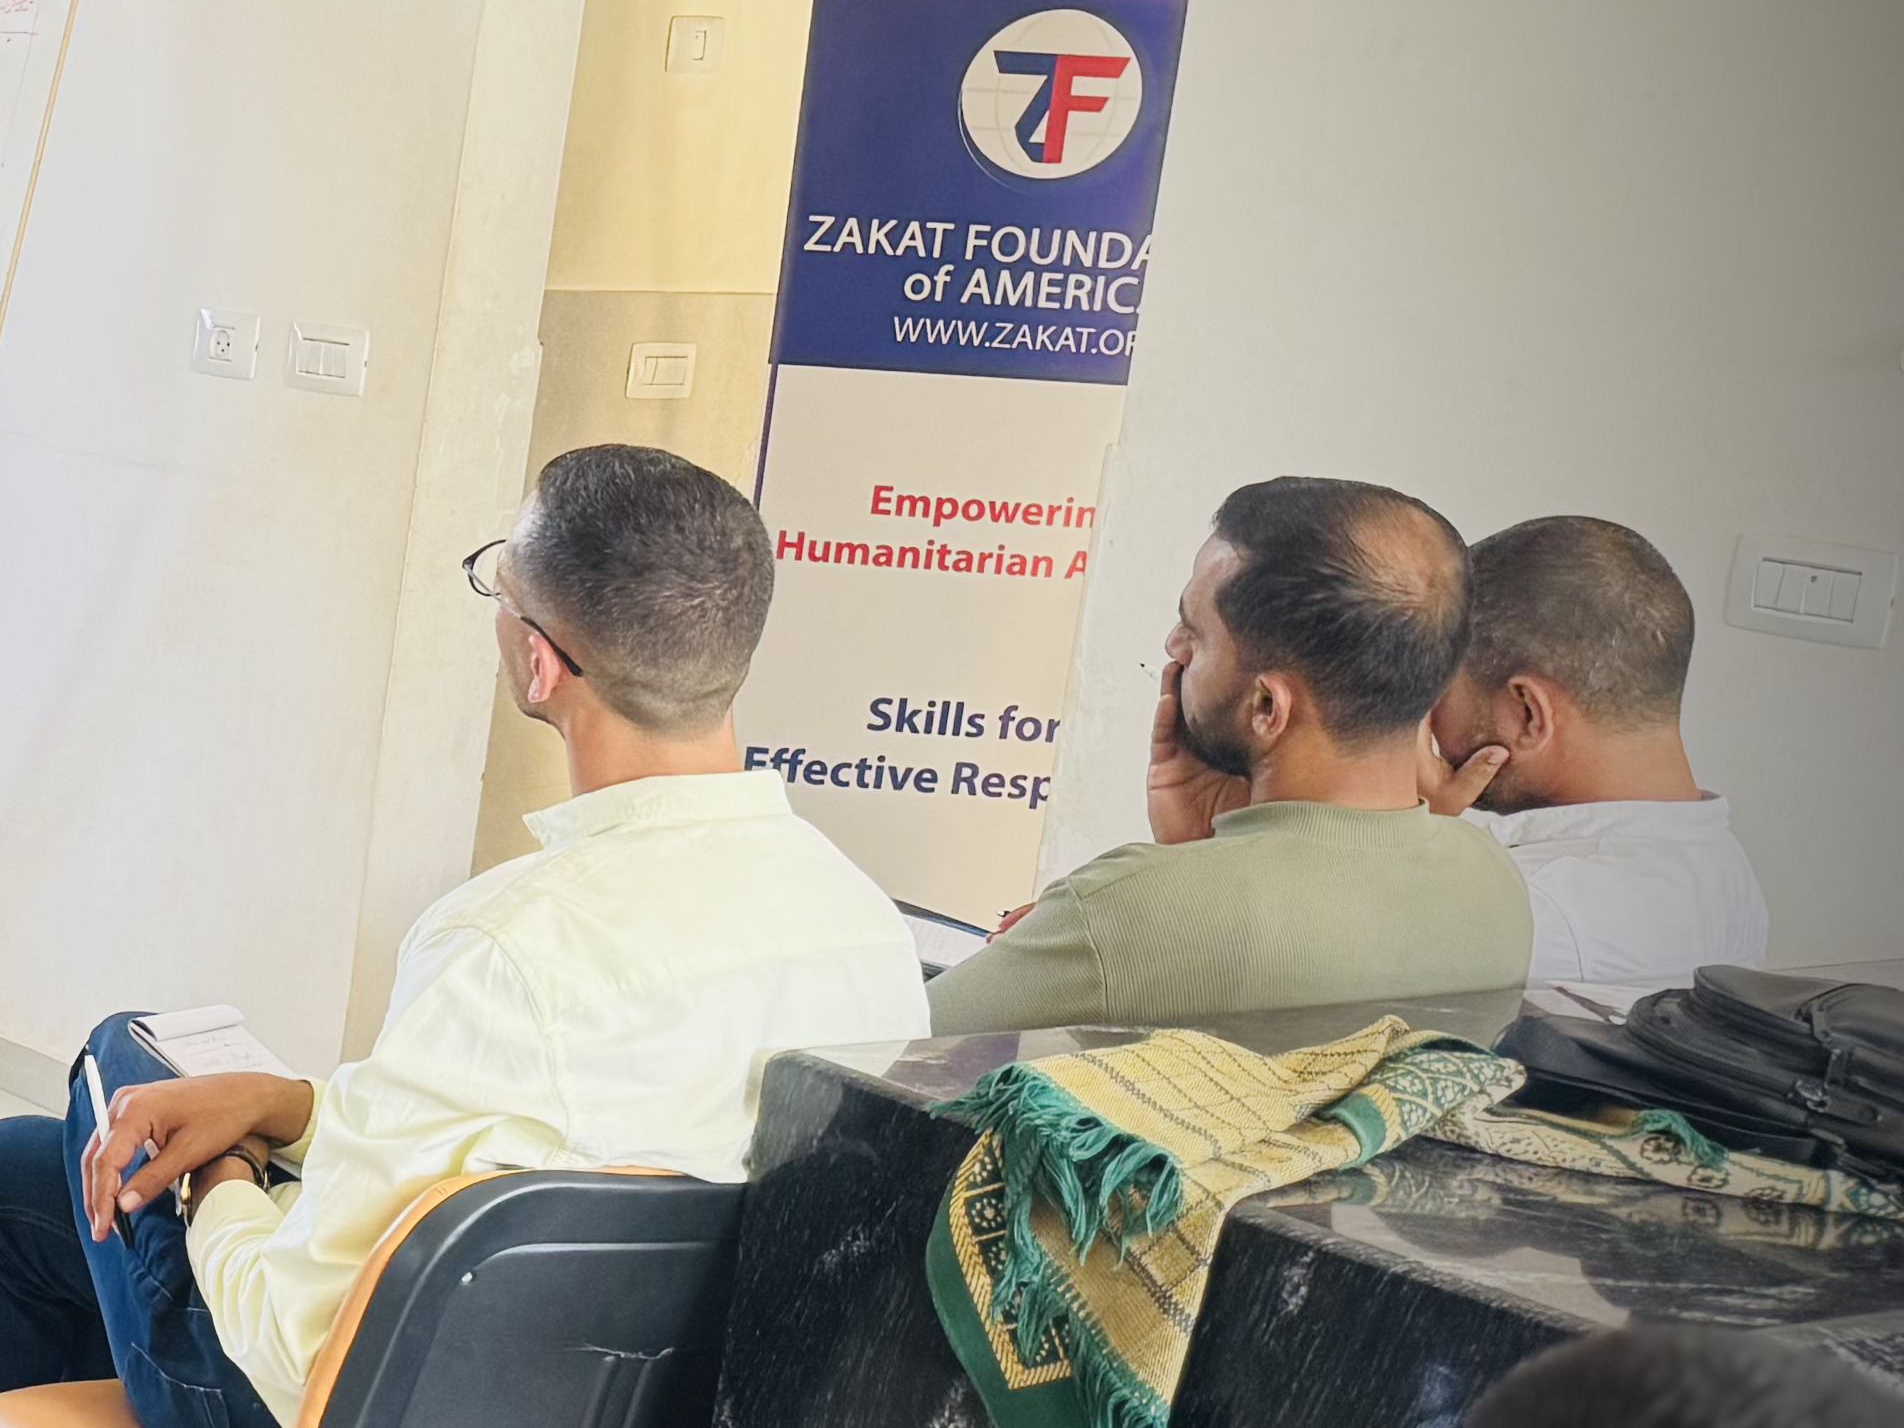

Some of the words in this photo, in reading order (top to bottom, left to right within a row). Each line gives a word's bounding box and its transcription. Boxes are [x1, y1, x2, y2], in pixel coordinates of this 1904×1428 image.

[803, 214, 956, 259] ZAKAT
[903, 264, 955, 302] of
[960, 267, 1142, 315] AMERIC
[870, 484, 1096, 529] Empowerin
[775, 530, 1054, 578] Humanitarian
[1063, 550, 1088, 580] A
[866, 696, 986, 738] Skills
[998, 704, 1061, 743] for
[744, 746, 938, 795] Effective
